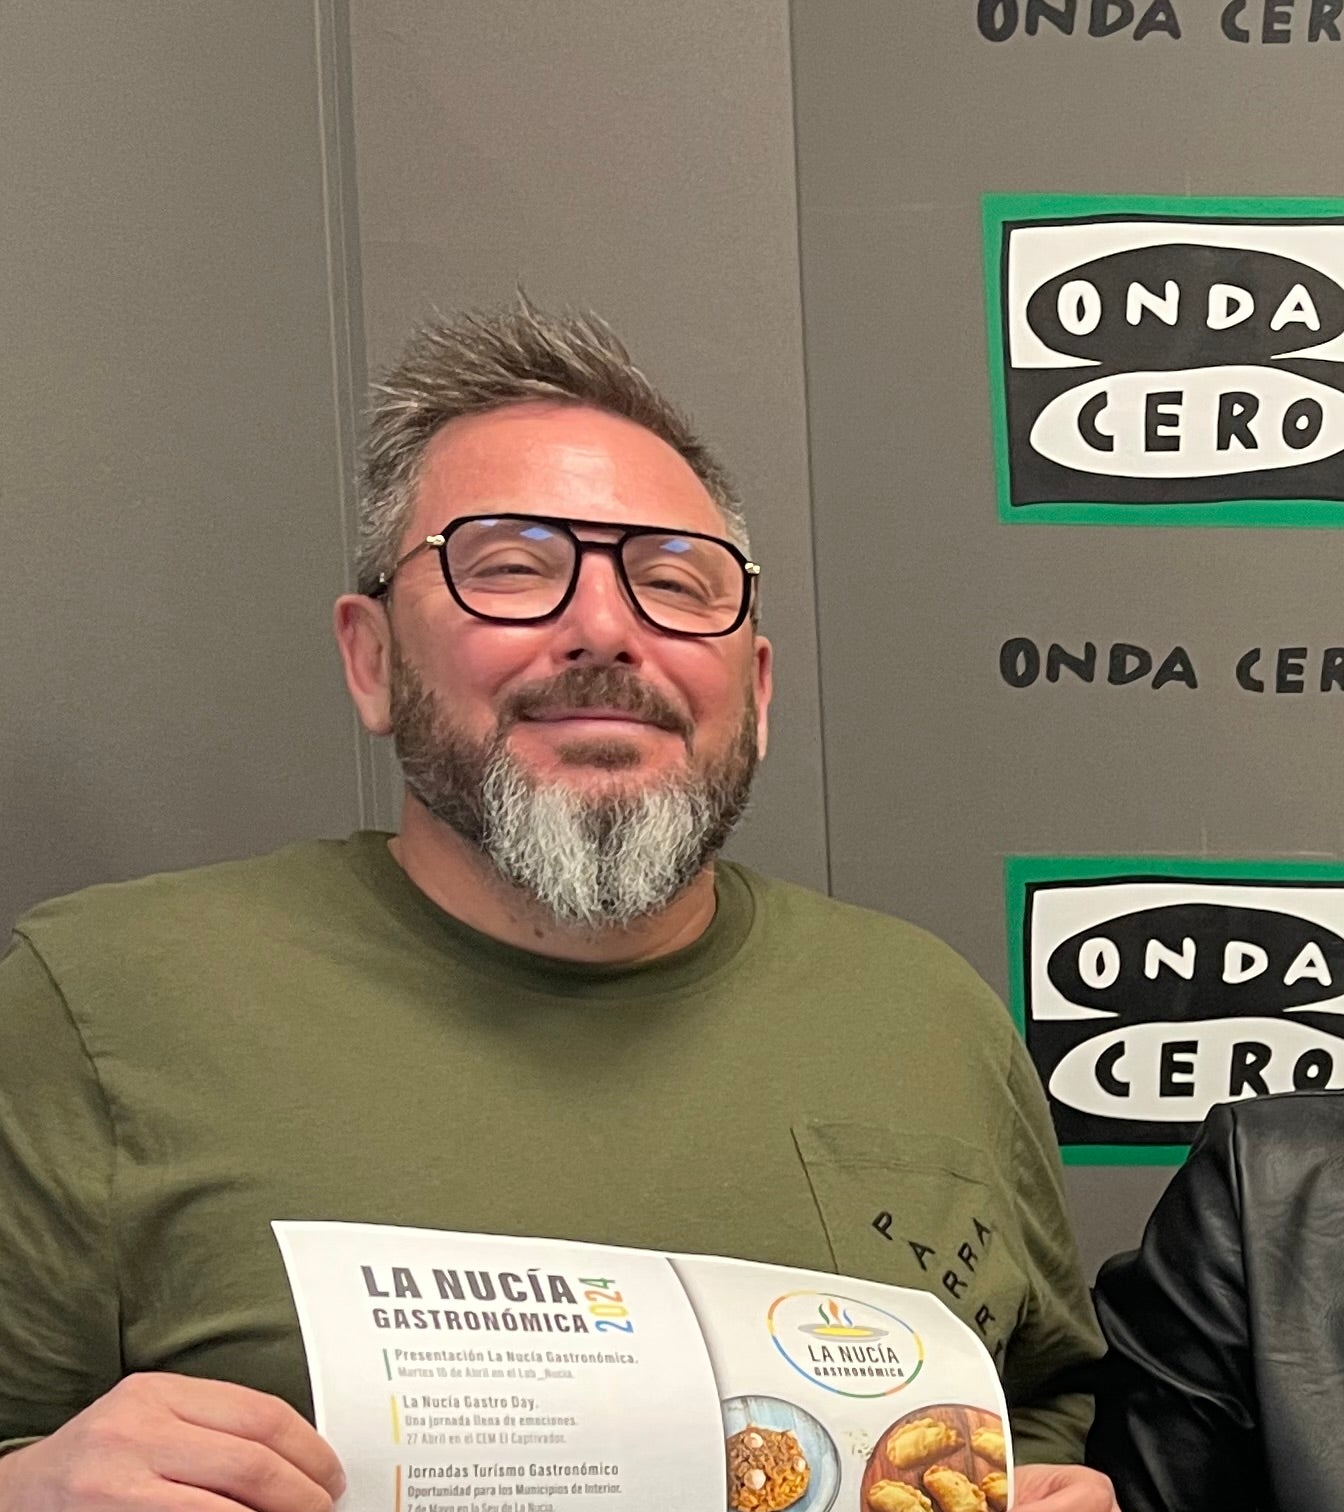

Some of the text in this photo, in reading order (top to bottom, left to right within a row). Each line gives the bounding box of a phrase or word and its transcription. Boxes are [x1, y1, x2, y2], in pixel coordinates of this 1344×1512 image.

[976, 0, 1182, 43] ONDA
[1057, 280, 1320, 335] ONDA
[1078, 390, 1323, 452] CERO
[1000, 637, 1198, 689] ONDA
[1079, 937, 1333, 988] ONDA
[1095, 1040, 1333, 1098] CERO
[361, 1265, 578, 1304] LA NUCÍA
[372, 1308, 589, 1333] GASTRONÓMICA
[578, 1277, 634, 1333] 2024
[395, 1349, 639, 1364] Presentación La Nucía Gastronómica.
[808, 1343, 899, 1364] LA NUCÍA
[814, 1367, 904, 1377] GASTRONÓMICA
[403, 1395, 538, 1411] La Nucía Gastro Day.
[408, 1464, 468, 1479] Jornadas
[529, 1463, 619, 1477] Gastronómico
[408, 1484, 621, 1498] Oportunidad para los Municipios de Interior.
